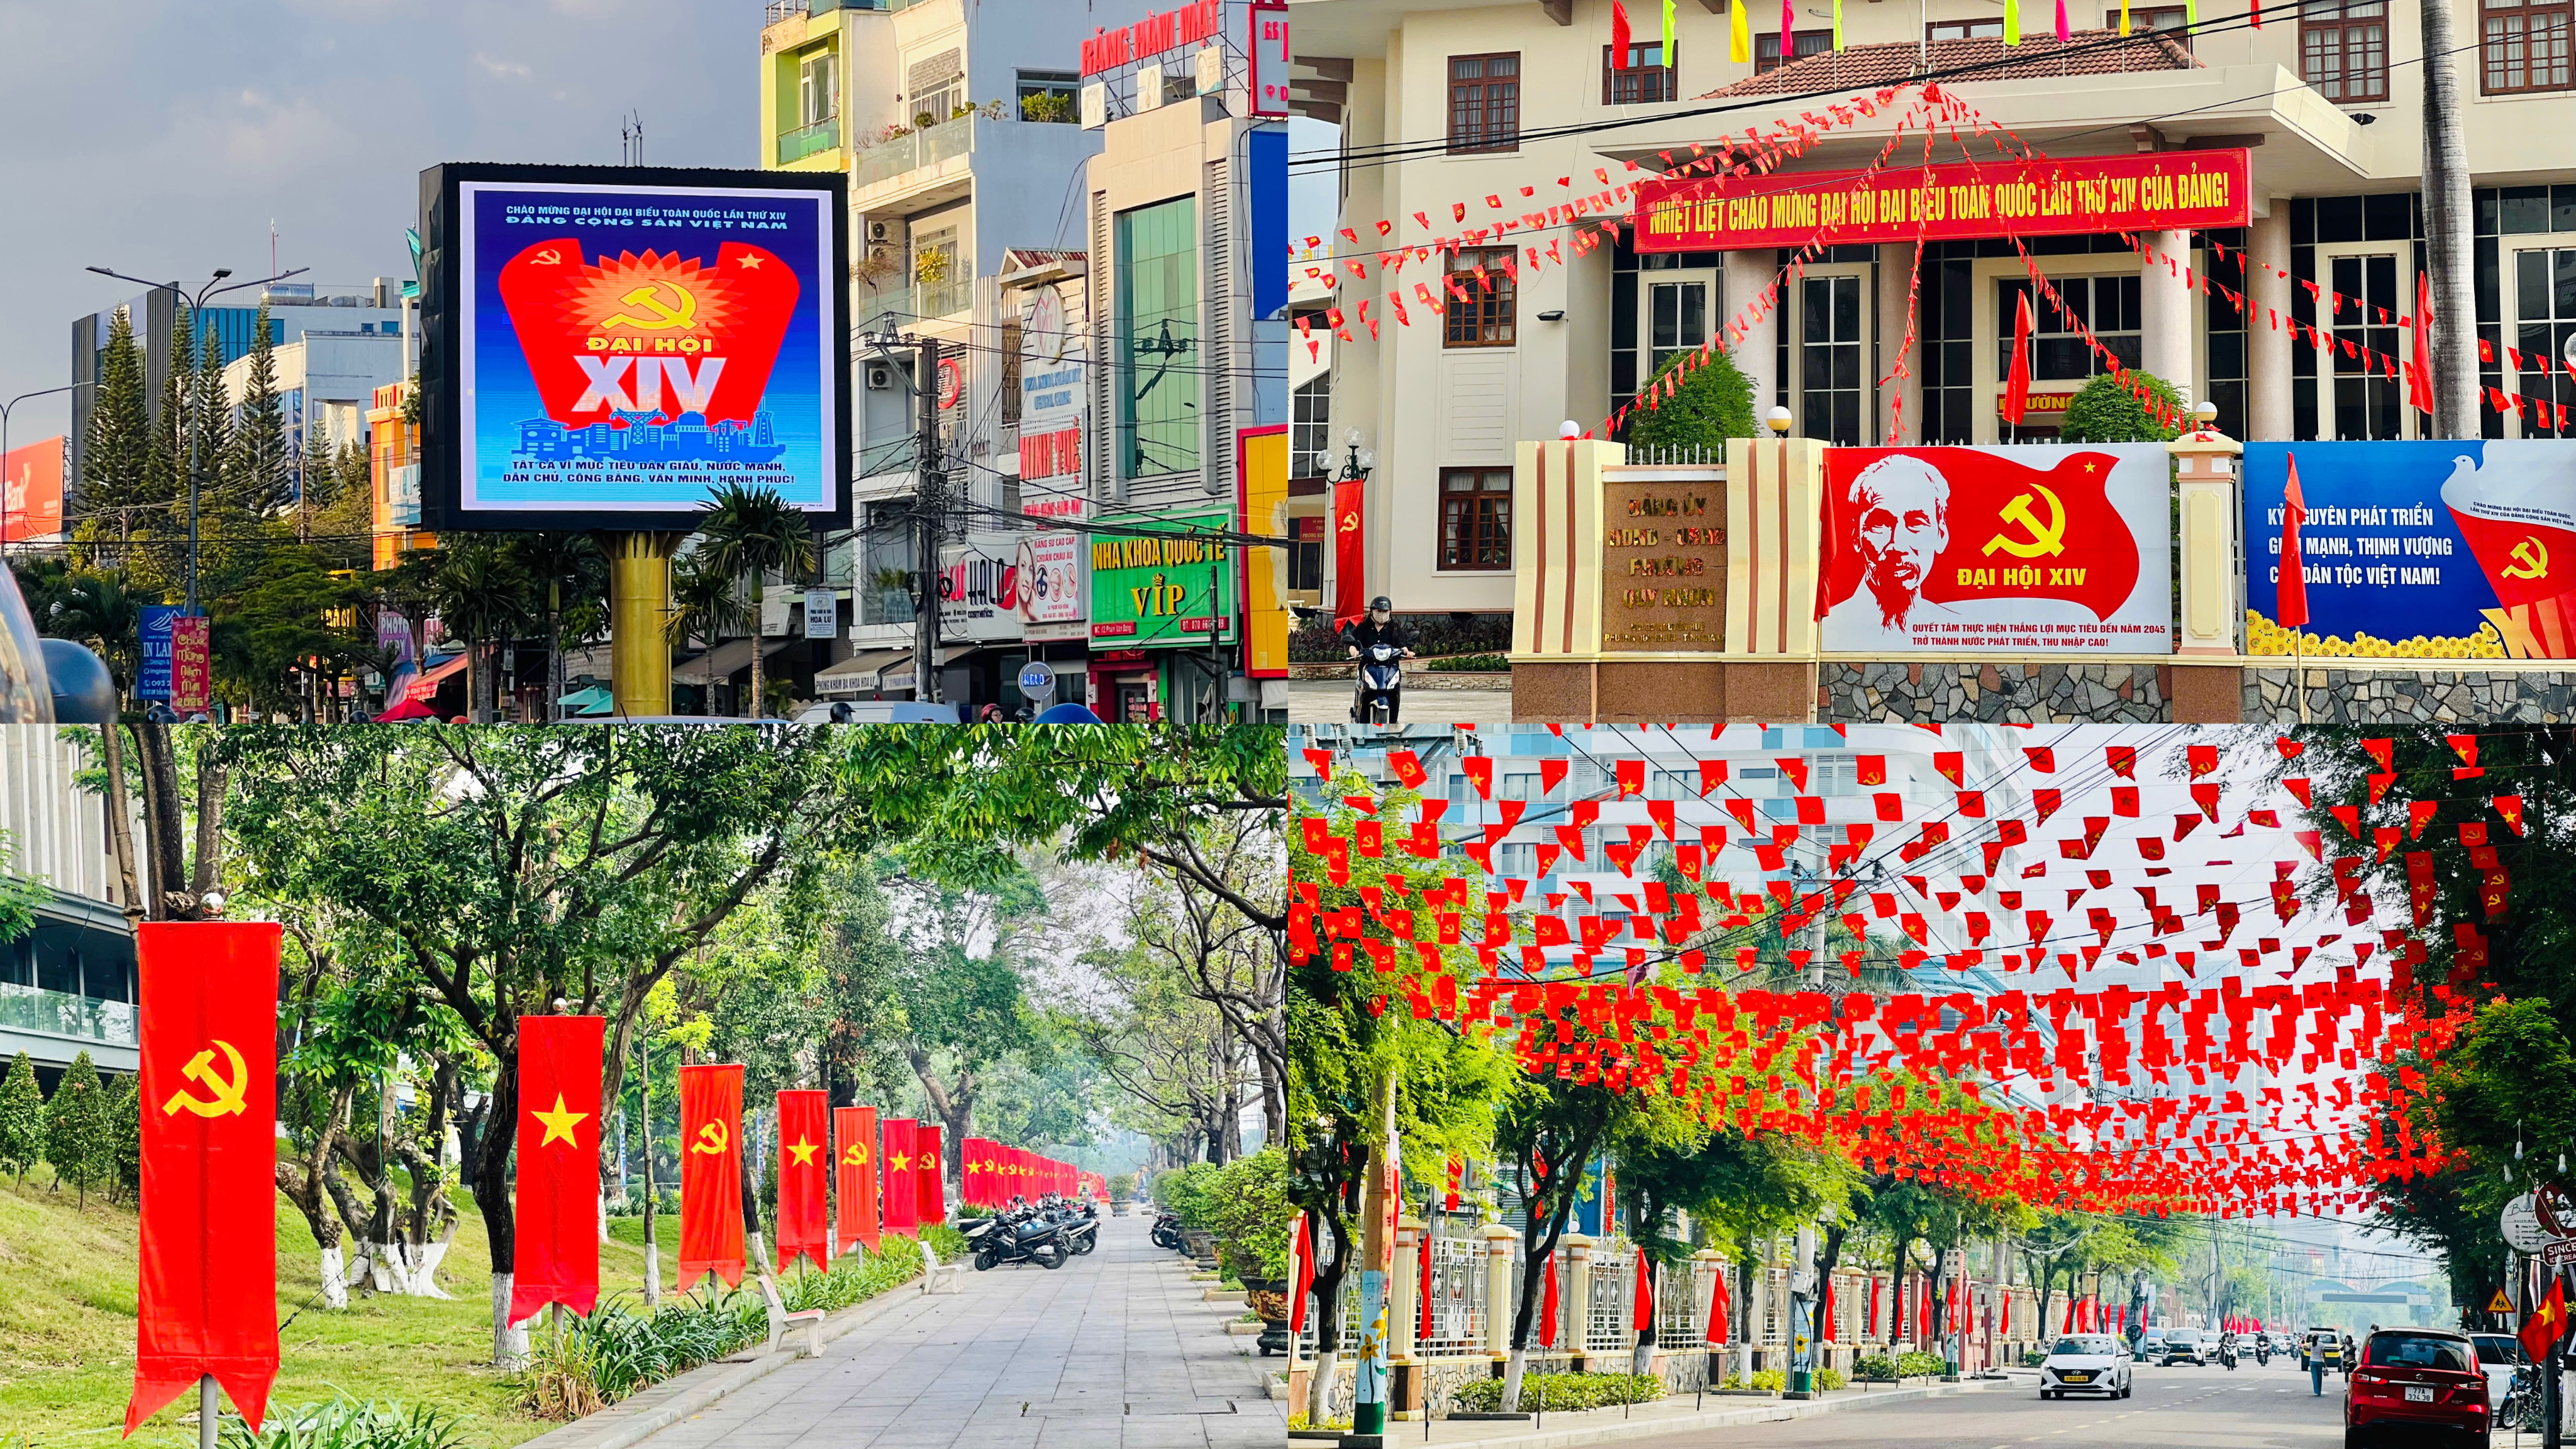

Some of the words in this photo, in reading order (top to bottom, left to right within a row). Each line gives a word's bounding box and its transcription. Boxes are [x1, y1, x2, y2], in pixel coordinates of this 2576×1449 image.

[1080, 26, 1130, 77] RĂNG
[1133, 10, 1175, 60] HÀM
[1695, 192, 1725, 239] LIỆT
[1729, 190, 1767, 231] CHÀO
[1772, 187, 1816, 226] MỪNG
[1821, 191, 1846, 233] ĐẠI
[1851, 184, 1876, 231] HỘI
[1880, 189, 1906, 230] ĐẠI
[1950, 178, 1990, 219] TOÀN
[1995, 170, 2036, 218] QUỐC
[2041, 169, 2072, 216] LẦN
[2077, 172, 2107, 214] THỨ
[2111, 177, 2137, 213] XIV
[2141, 164, 2174, 211] CỦA
[2179, 162, 2229, 208] ĐẢNG!
[506, 204, 535, 214] CHÀO
[538, 205, 570, 214] MỪNG
[573, 207, 591, 217] ĐẠI
[594, 206, 611, 217] HỘI
[614, 208, 632, 218] ĐẠI
[636, 206, 659, 217] BIỂU
[662, 208, 689, 218] TOÀN
[692, 208, 720, 218] QUỐC
[747, 210, 767, 219] THỨ
[769, 212, 786, 220] XIV
[575, 216, 634, 226] CỘNG
[689, 219, 733, 230] VIỆT
[586, 336, 643, 355] ĐẠI
[655, 334, 713, 354] HỘI
[571, 355, 726, 413] XIV
[538, 458, 555, 469] CẢ
[560, 460, 571, 469] VÌ
[575, 462, 604, 471] MỤC
[608, 460, 635, 470] TIÊU
[640, 460, 665, 470] DÂN
[1020, 432, 1053, 480] MINH
[503, 472, 529, 482] DÂN
[567, 472, 602, 482] CÔNG
[648, 473, 673, 483] VĂN
[757, 474, 794, 484] PHÚC!
[2268, 503, 2285, 525] KỶ
[2302, 505, 2346, 525] GUYÊN
[2351, 505, 2387, 525] PHÁT
[2391, 502, 2433, 525] TRIỂN
[1056, 537, 1065, 547] CAO
[1609, 528, 1658, 547] HDND
[2306, 538, 2353, 558] MẠNH,
[2357, 538, 2399, 558] THỊNH
[2403, 536, 2452, 558] VƯỢNG
[1093, 543, 1122, 570] NHA
[1124, 538, 1162, 567] KHOA
[1165, 526, 1204, 567] QUỐC
[967, 558, 1004, 606] HALO
[1957, 568, 1996, 590] ĐẠI
[2004, 565, 2041, 590] HỘI
[2049, 568, 2087, 586] XIV
[2304, 564, 2331, 584] DÂN
[2335, 564, 2362, 587] TỘC
[2367, 564, 2397, 588] VIỆT
[2401, 567, 2440, 584] NAM!
[1131, 585, 1185, 617] VIP
[1622, 589, 1657, 608] QUY
[380, 616, 409, 635] PHOTO
[1913, 622, 1938, 632] QUYẾT
[1941, 623, 1959, 632] TÂM
[1962, 624, 1984, 634] THỰC
[1987, 623, 2006, 634] HIỆN
[2009, 621, 2038, 633] THẮNG
[2040, 624, 2053, 634] LỢI
[2057, 625, 2076, 635] MỤC
[2079, 623, 2097, 633] TIÊU
[2100, 623, 2118, 633] ĐẾN
[2121, 624, 2141, 633] NĂM
[2144, 625, 2165, 633] 2045
[143, 642, 153, 657] IN
[1913, 635, 1928, 645] TRỞ
[1931, 636, 1959, 645] THÀNH
[1962, 636, 1985, 646] NƯỚC
[1988, 636, 2009, 646] PHÁT
[2012, 635, 2040, 647] TRIỂN,
[2042, 638, 2058, 646] THU
[2061, 636, 2085, 648] NHẬP
[2088, 638, 2109, 646] CAO!
[177, 697, 204, 707] 2026
